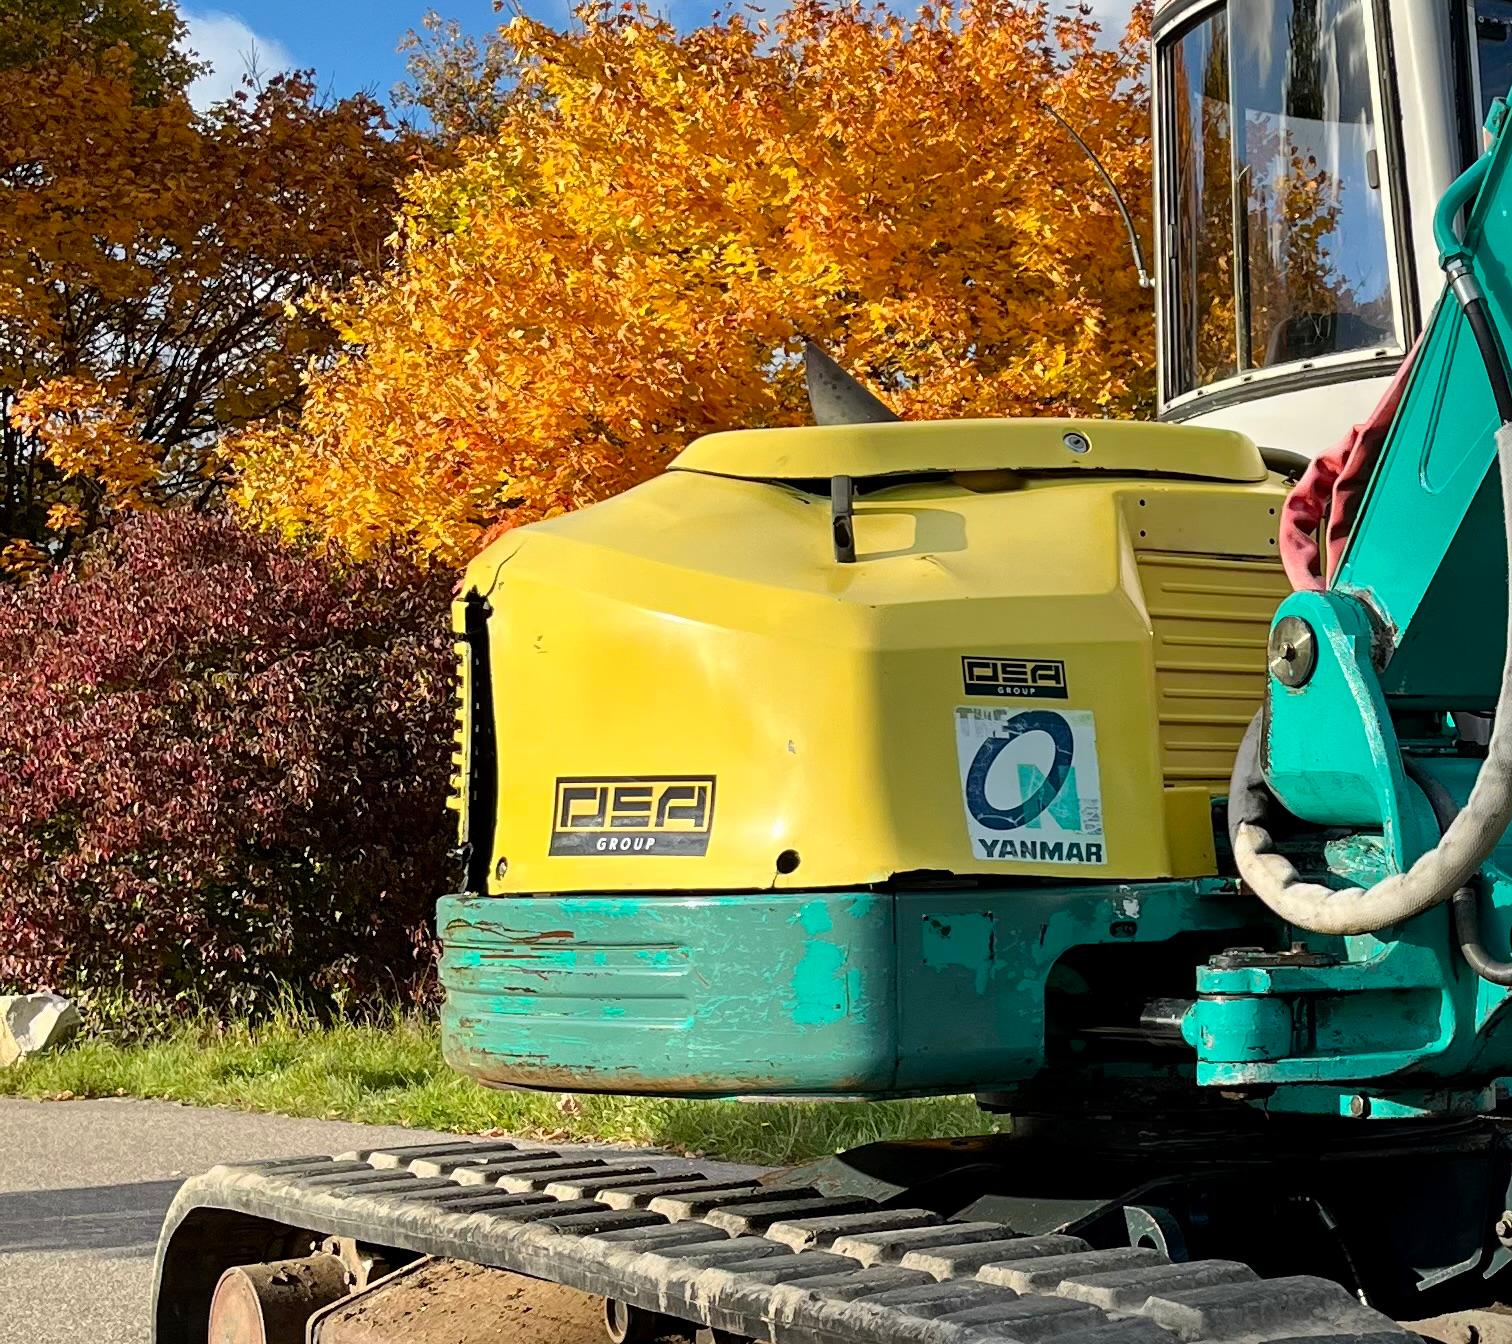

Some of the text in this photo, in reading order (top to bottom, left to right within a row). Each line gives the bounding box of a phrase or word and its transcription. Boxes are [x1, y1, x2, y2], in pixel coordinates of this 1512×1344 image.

[997, 686, 1036, 696] GROUP
[596, 837, 656, 851] GROUP
[978, 838, 1103, 863] YANMAR
